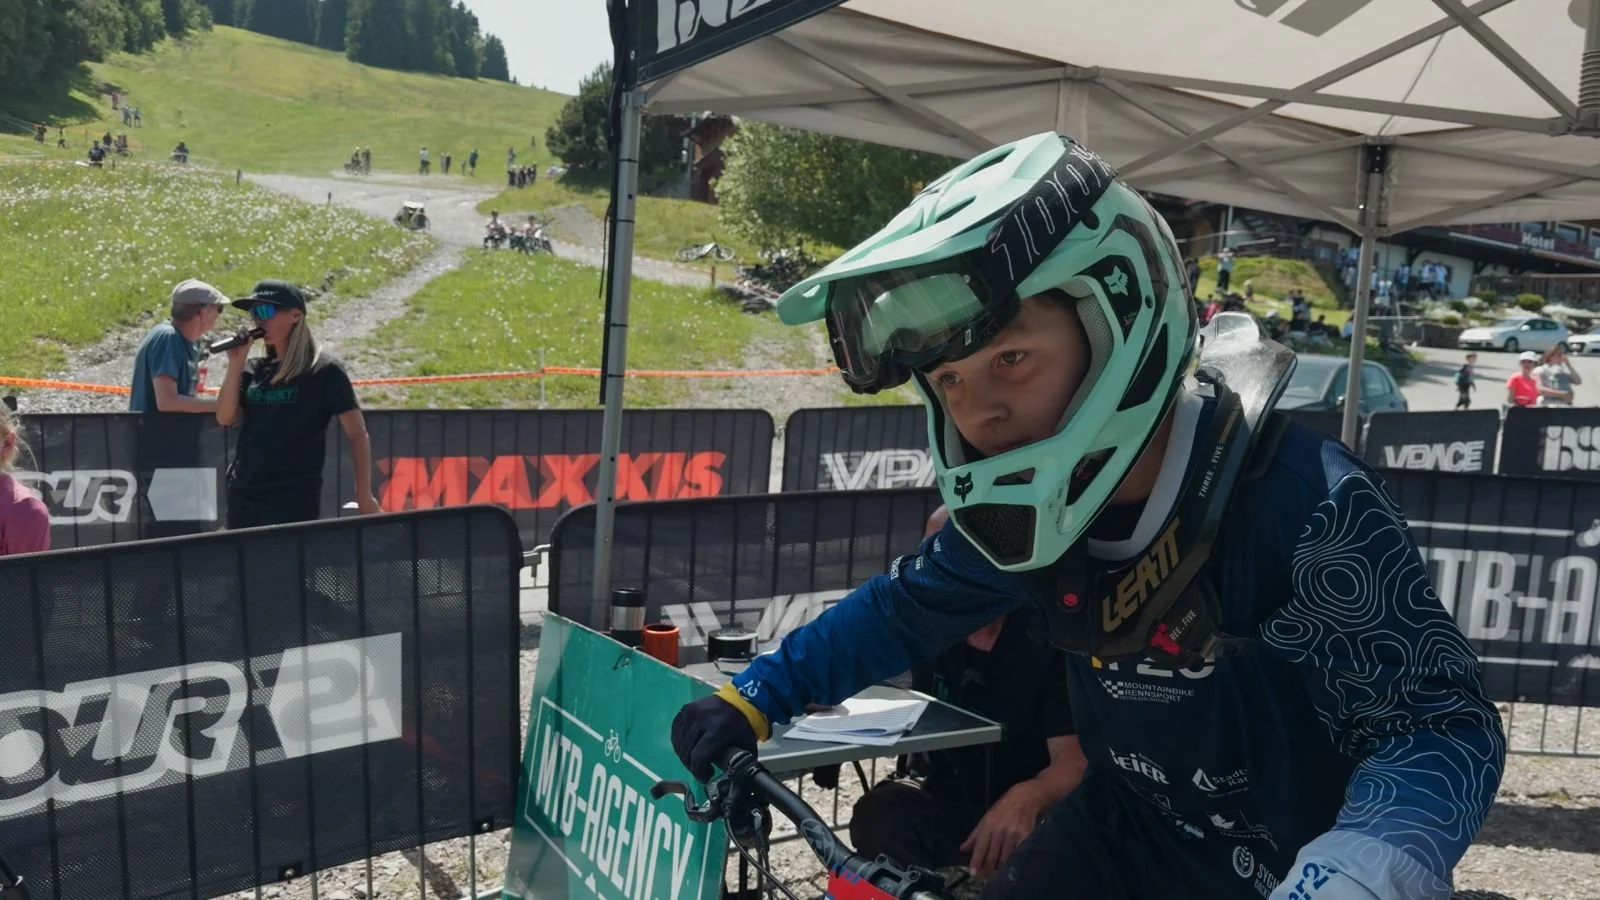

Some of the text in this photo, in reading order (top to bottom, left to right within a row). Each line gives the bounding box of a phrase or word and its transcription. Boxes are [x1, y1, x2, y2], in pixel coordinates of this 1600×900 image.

[1522, 231, 1555, 252] Hotel
[1198, 443, 1224, 498] THREE FIVE
[1383, 440, 1485, 473] VPACE
[378, 452, 726, 511] MAXXIS
[1102, 516, 1180, 632] LEATT
[1418, 546, 1600, 645] TB-A
[1182, 609, 1197, 627] FIVE
[1124, 682, 1196, 697] MOUNTAINBIKE
[1125, 689, 1182, 702] RENNSPORT
[535, 723, 694, 900] MTB-AGENCY
